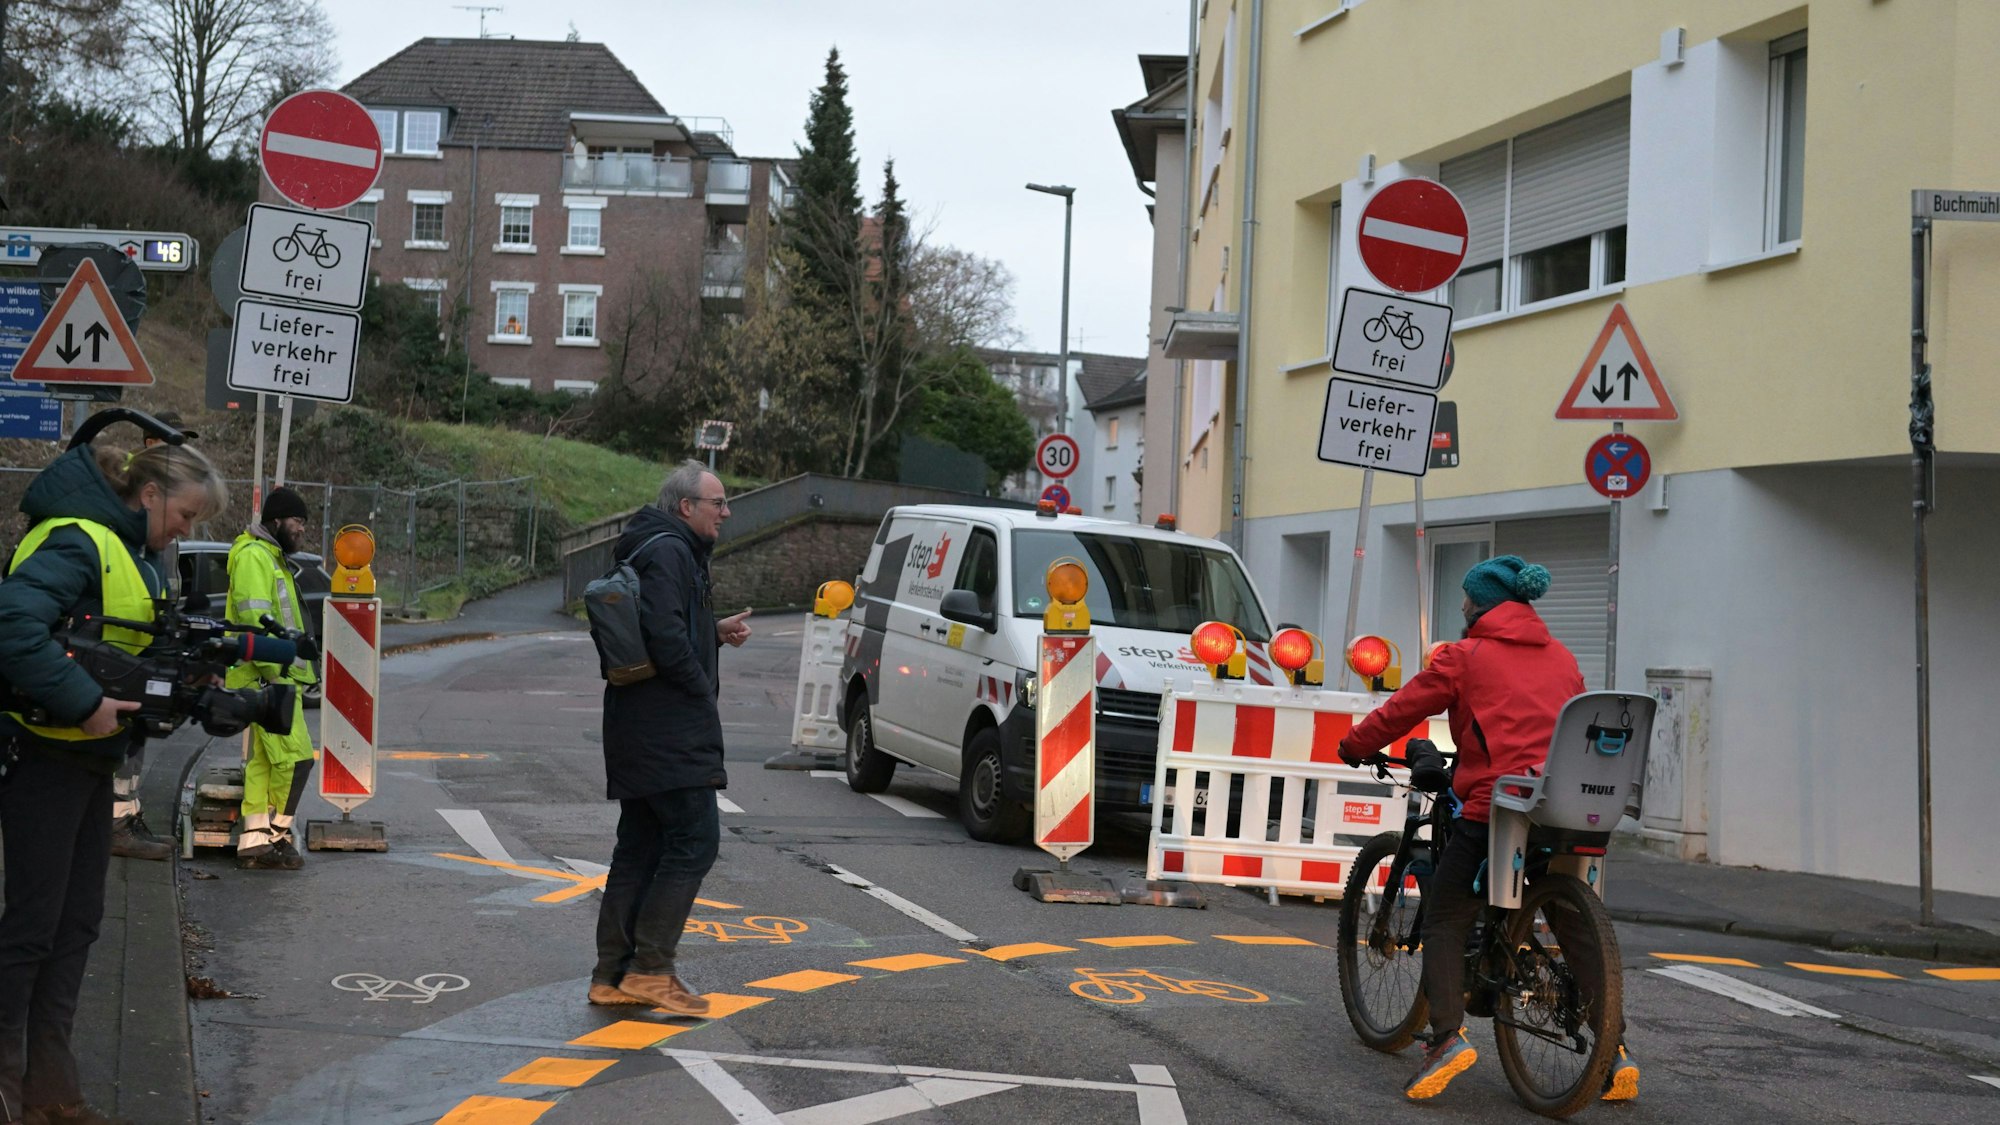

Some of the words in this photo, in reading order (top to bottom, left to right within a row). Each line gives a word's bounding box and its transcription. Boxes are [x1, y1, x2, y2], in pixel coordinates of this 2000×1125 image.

[1934, 194, 2000, 214] Buchmühl
[157, 241, 180, 262] 46
[285, 269, 322, 292] frei
[260, 312, 335, 337] Liefer-
[251, 340, 338, 364] verkehr
[1372, 349, 1406, 372] frei
[273, 364, 310, 386] frei
[1347, 389, 1415, 416] Liefer-
[1340, 416, 1417, 441] verkehr
[1046, 446, 1071, 467] 30
[1358, 440, 1391, 462] frei
[907, 540, 933, 578] step
[1118, 646, 1174, 661] step
[1581, 783, 1615, 795] THULE
[1344, 805, 1363, 815] step
